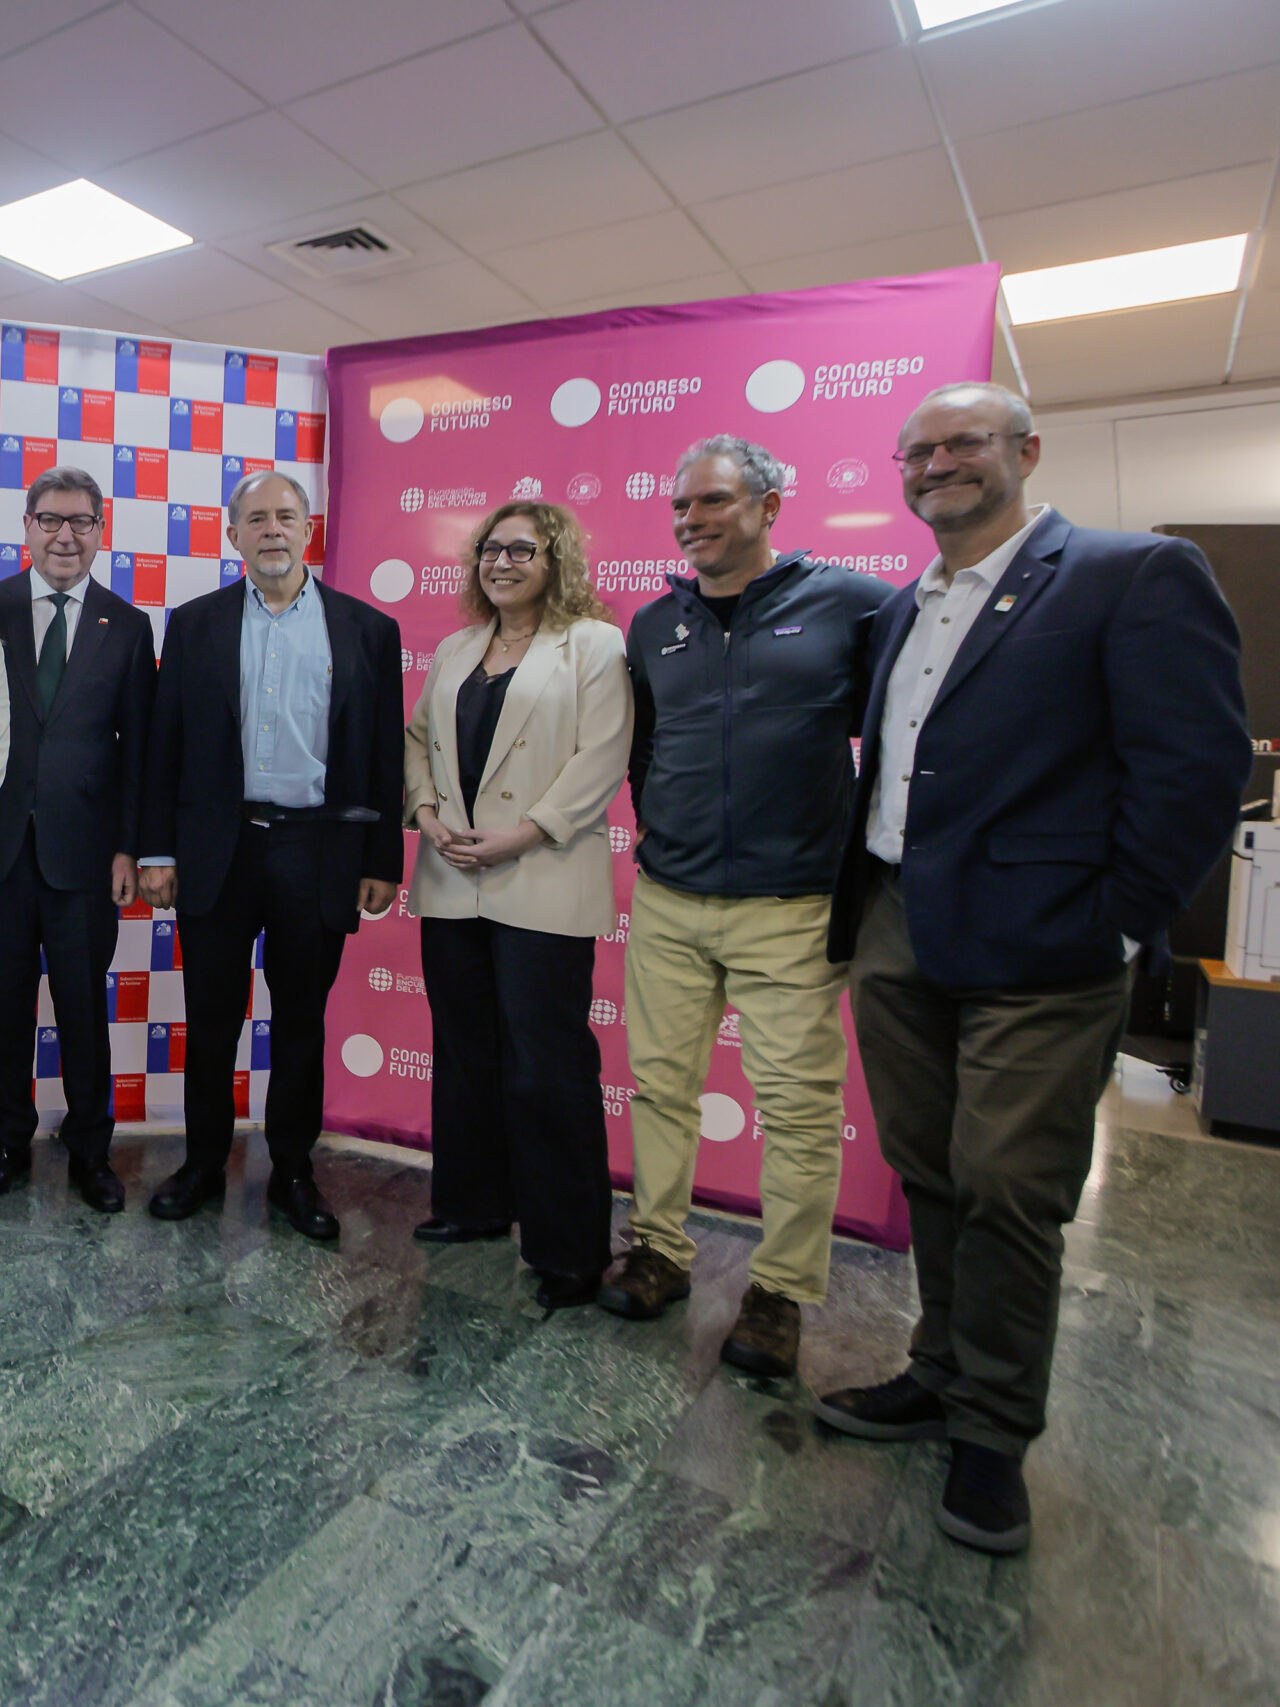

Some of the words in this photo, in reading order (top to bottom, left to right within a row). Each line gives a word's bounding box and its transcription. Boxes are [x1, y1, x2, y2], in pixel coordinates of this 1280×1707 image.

[815, 355, 924, 383] CONGRESO
[609, 377, 702, 399] CONGRESO
[813, 377, 893, 401] FUTURO
[431, 394, 512, 417] CONGRESO
[608, 396, 676, 416] FUTURO
[430, 412, 489, 433] FUTURO
[421, 565, 466, 580] CONG
[597, 559, 689, 576] CONGRESO
[596, 576, 663, 592] FUTURO
